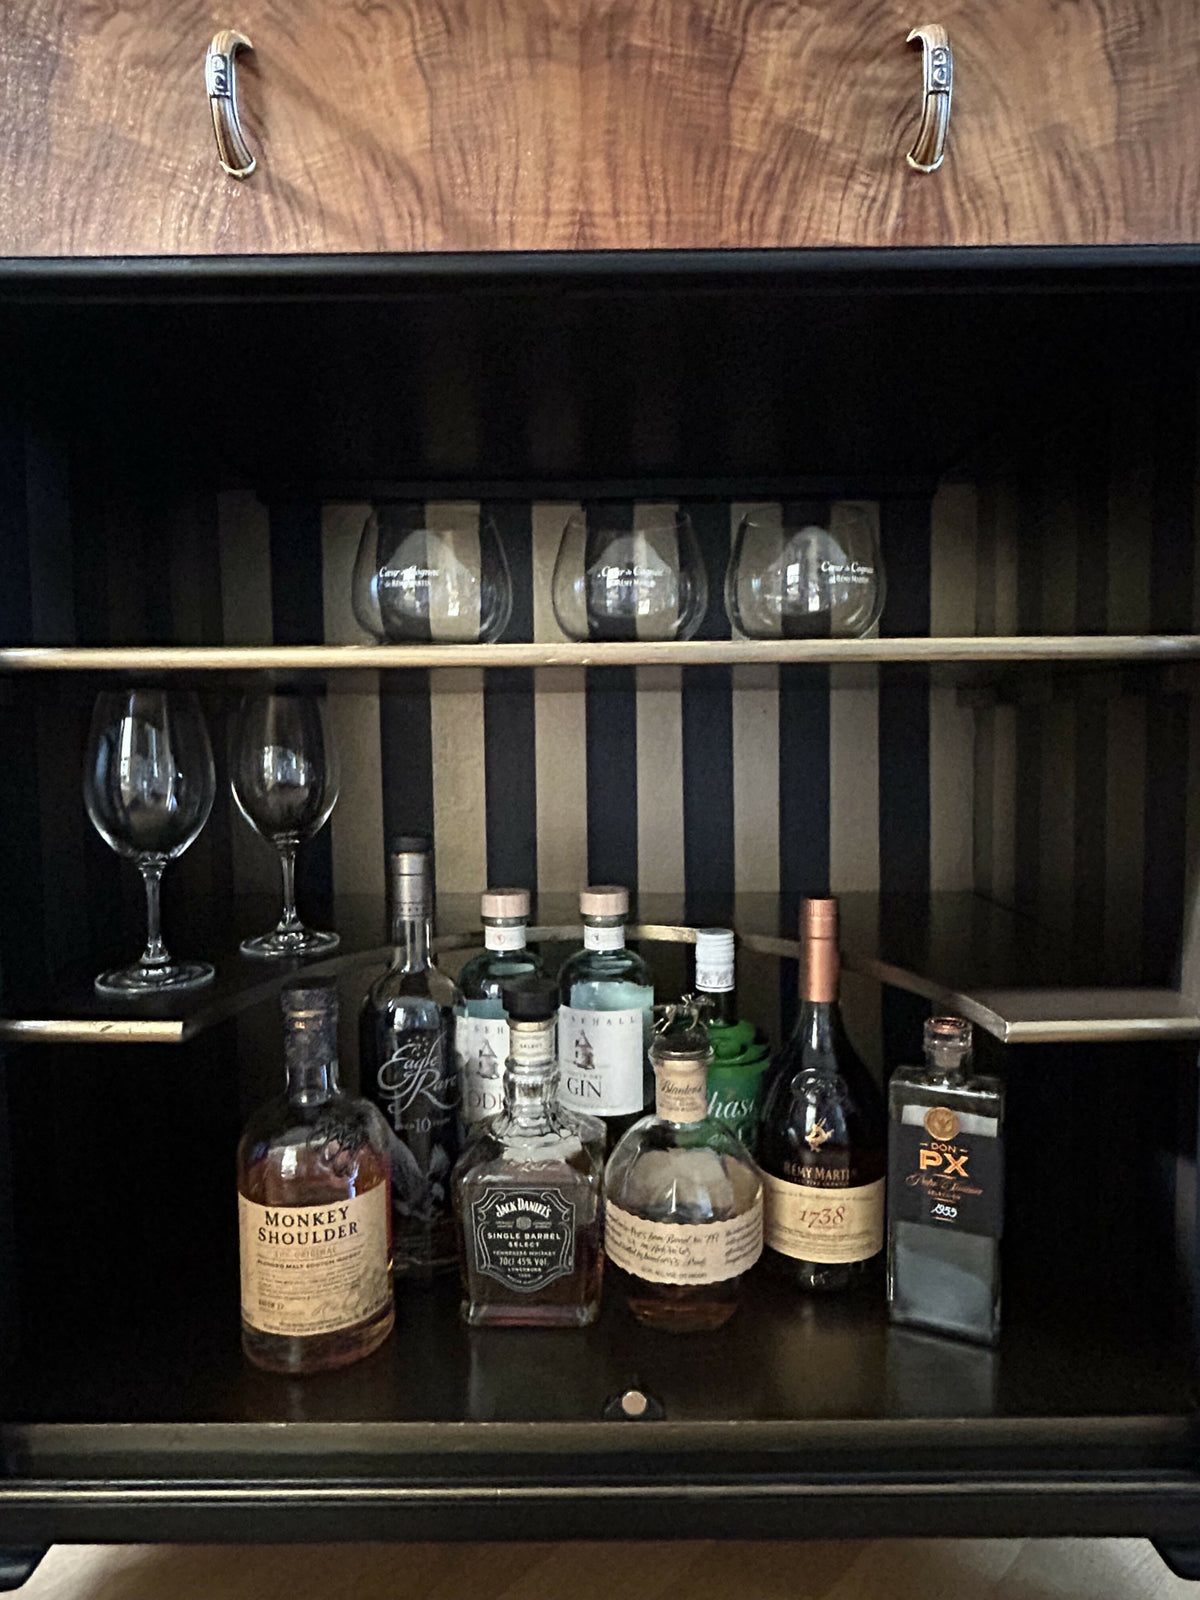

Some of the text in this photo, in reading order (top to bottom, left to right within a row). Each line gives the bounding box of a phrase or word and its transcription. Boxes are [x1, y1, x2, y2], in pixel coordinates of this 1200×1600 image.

[377, 1031, 447, 1100] Eagle
[387, 1069, 462, 1113] Rare
[567, 1077, 601, 1098] GIN
[931, 1142, 956, 1153] DON
[919, 1149, 969, 1177] PX
[265, 1206, 349, 1228] MONKEY
[496, 1198, 552, 1219] JACK DANIEL'S
[800, 1206, 845, 1228] 1738
[258, 1221, 358, 1245] SHOULDER
[487, 1232, 561, 1240] SINGLE BARREL
[306, 1259, 335, 1269] SCOTCH
[517, 1256, 533, 1266] 45%
